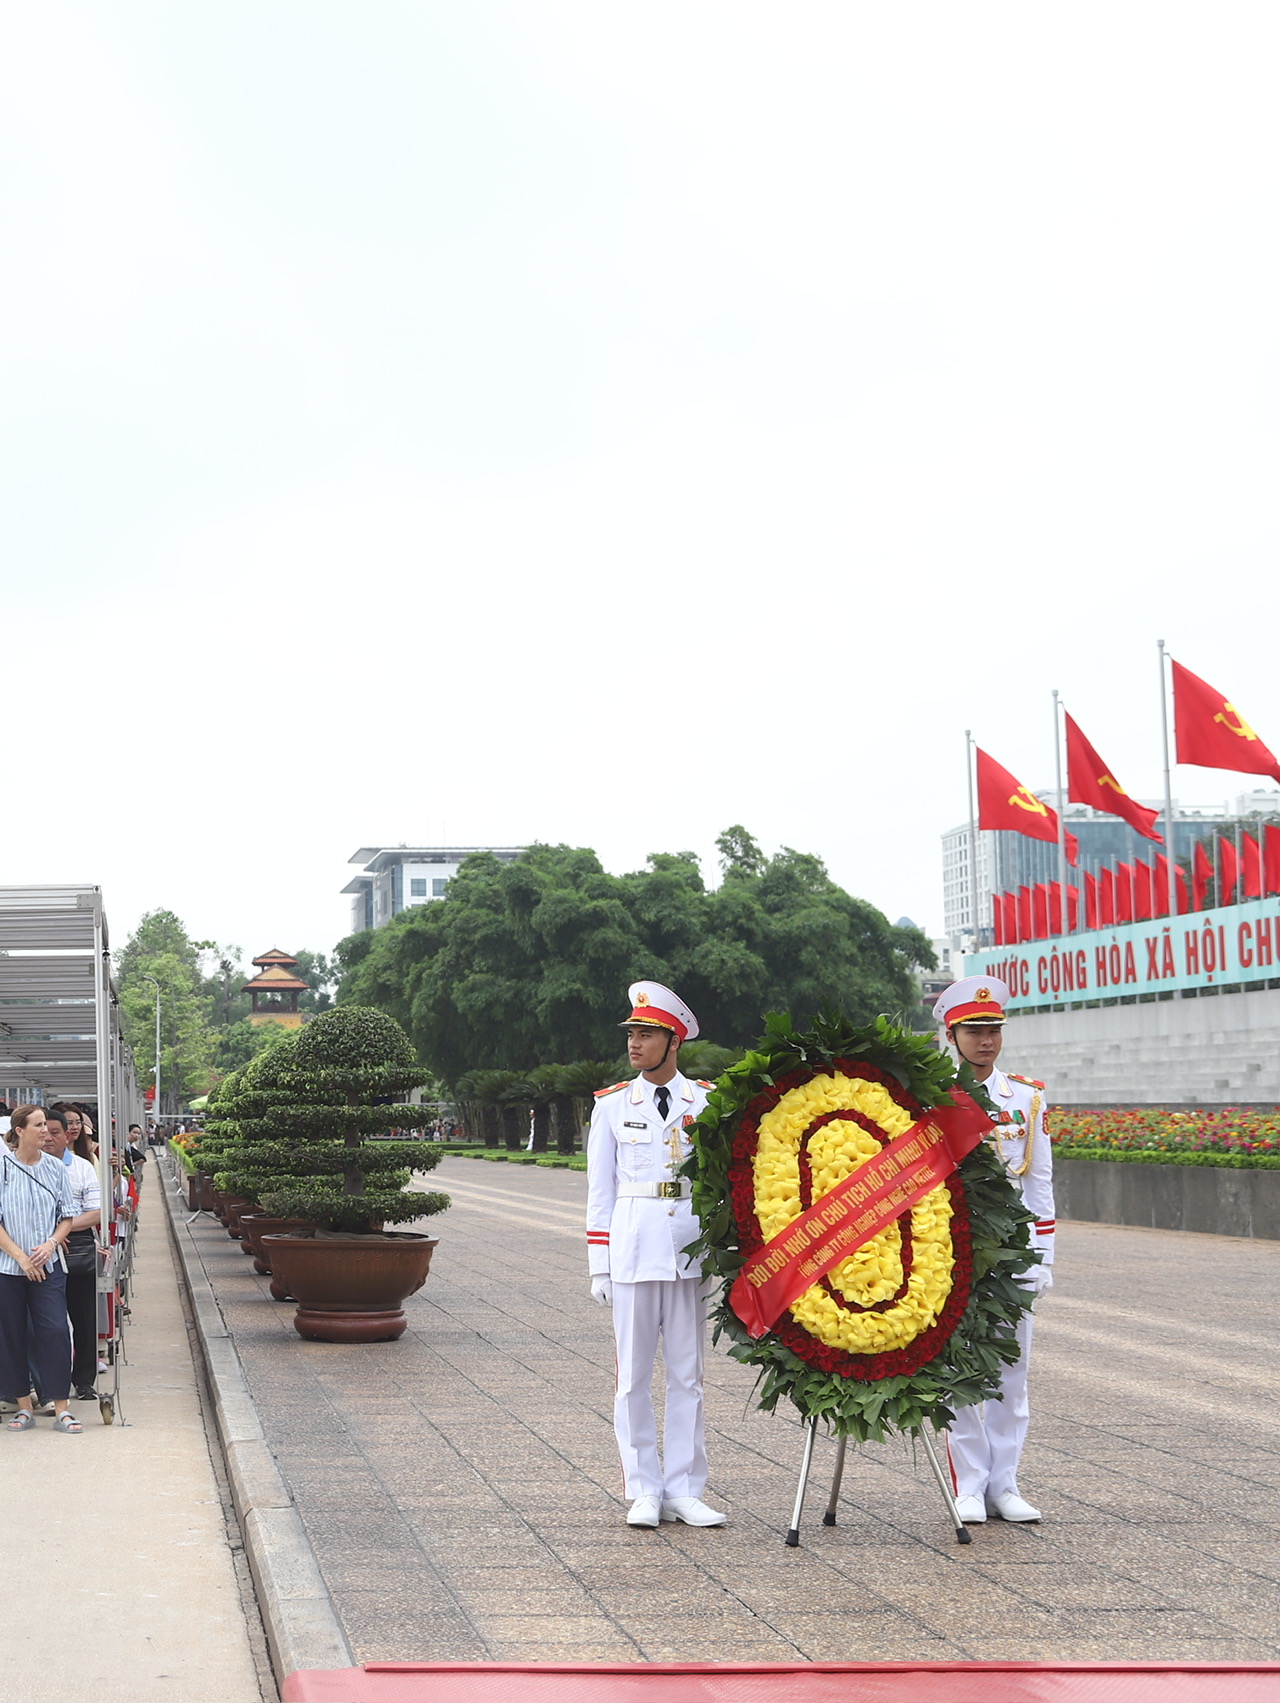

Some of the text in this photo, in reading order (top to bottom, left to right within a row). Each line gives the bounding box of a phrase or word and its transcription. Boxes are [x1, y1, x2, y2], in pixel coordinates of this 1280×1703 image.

[1037, 945, 1087, 1000] CỘNG
[1095, 936, 1137, 987] HÒA
[1145, 926, 1175, 981] XÃ
[1184, 917, 1226, 982] HỘI
[746, 1264, 773, 1289] ĐỜI
[764, 1248, 790, 1274] ĐỜI
[782, 1227, 811, 1258] NHỚ
[805, 1216, 828, 1239] ƠN
[821, 1196, 849, 1226] CHỦ
[840, 1181, 872, 1209] TỊCH
[863, 1165, 885, 1192] HỒ
[878, 1154, 901, 1181] CHÍ
[894, 1139, 924, 1169] MINH
[813, 1245, 835, 1266] CÔNG
[828, 1238, 843, 1253] TY
[837, 1225, 860, 1246] CÔNG
[853, 1209, 879, 1234] NGHIỆP
[873, 1197, 895, 1218] CÔNG
[902, 1178, 918, 1195] CAO
